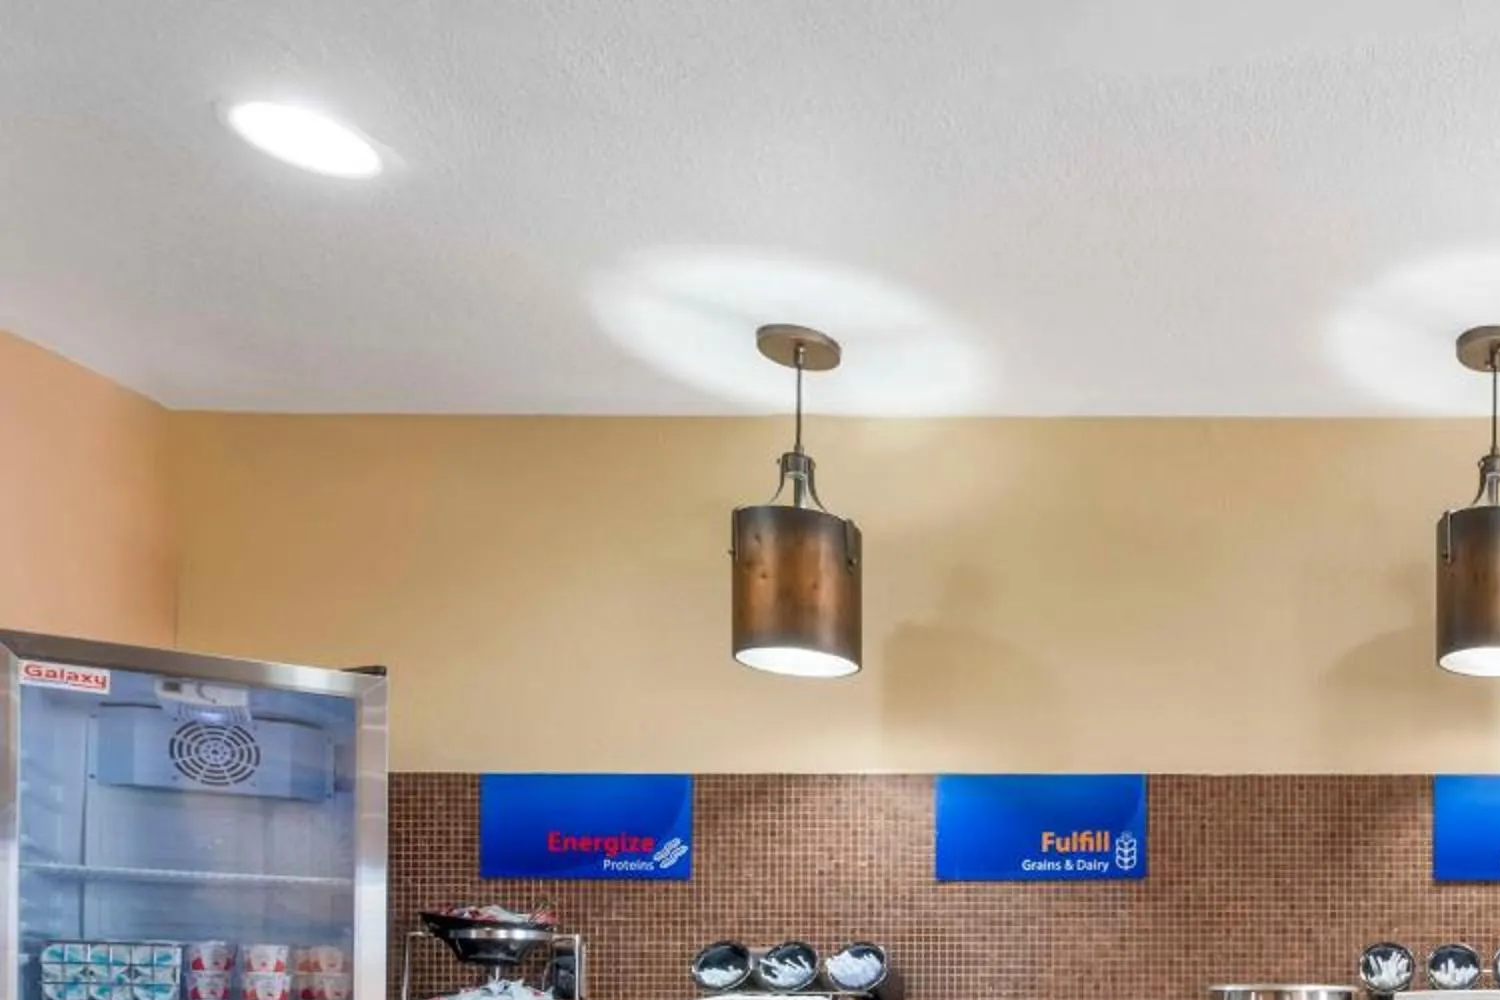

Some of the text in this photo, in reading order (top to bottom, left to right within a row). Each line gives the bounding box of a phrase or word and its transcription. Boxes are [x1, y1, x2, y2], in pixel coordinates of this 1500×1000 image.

[24, 663, 107, 689] Galaxy
[547, 831, 655, 857] Energize
[1041, 831, 1110, 853] Fulfill
[603, 859, 655, 871] Proteins
[1021, 859, 1110, 873] Grains & Dairy
